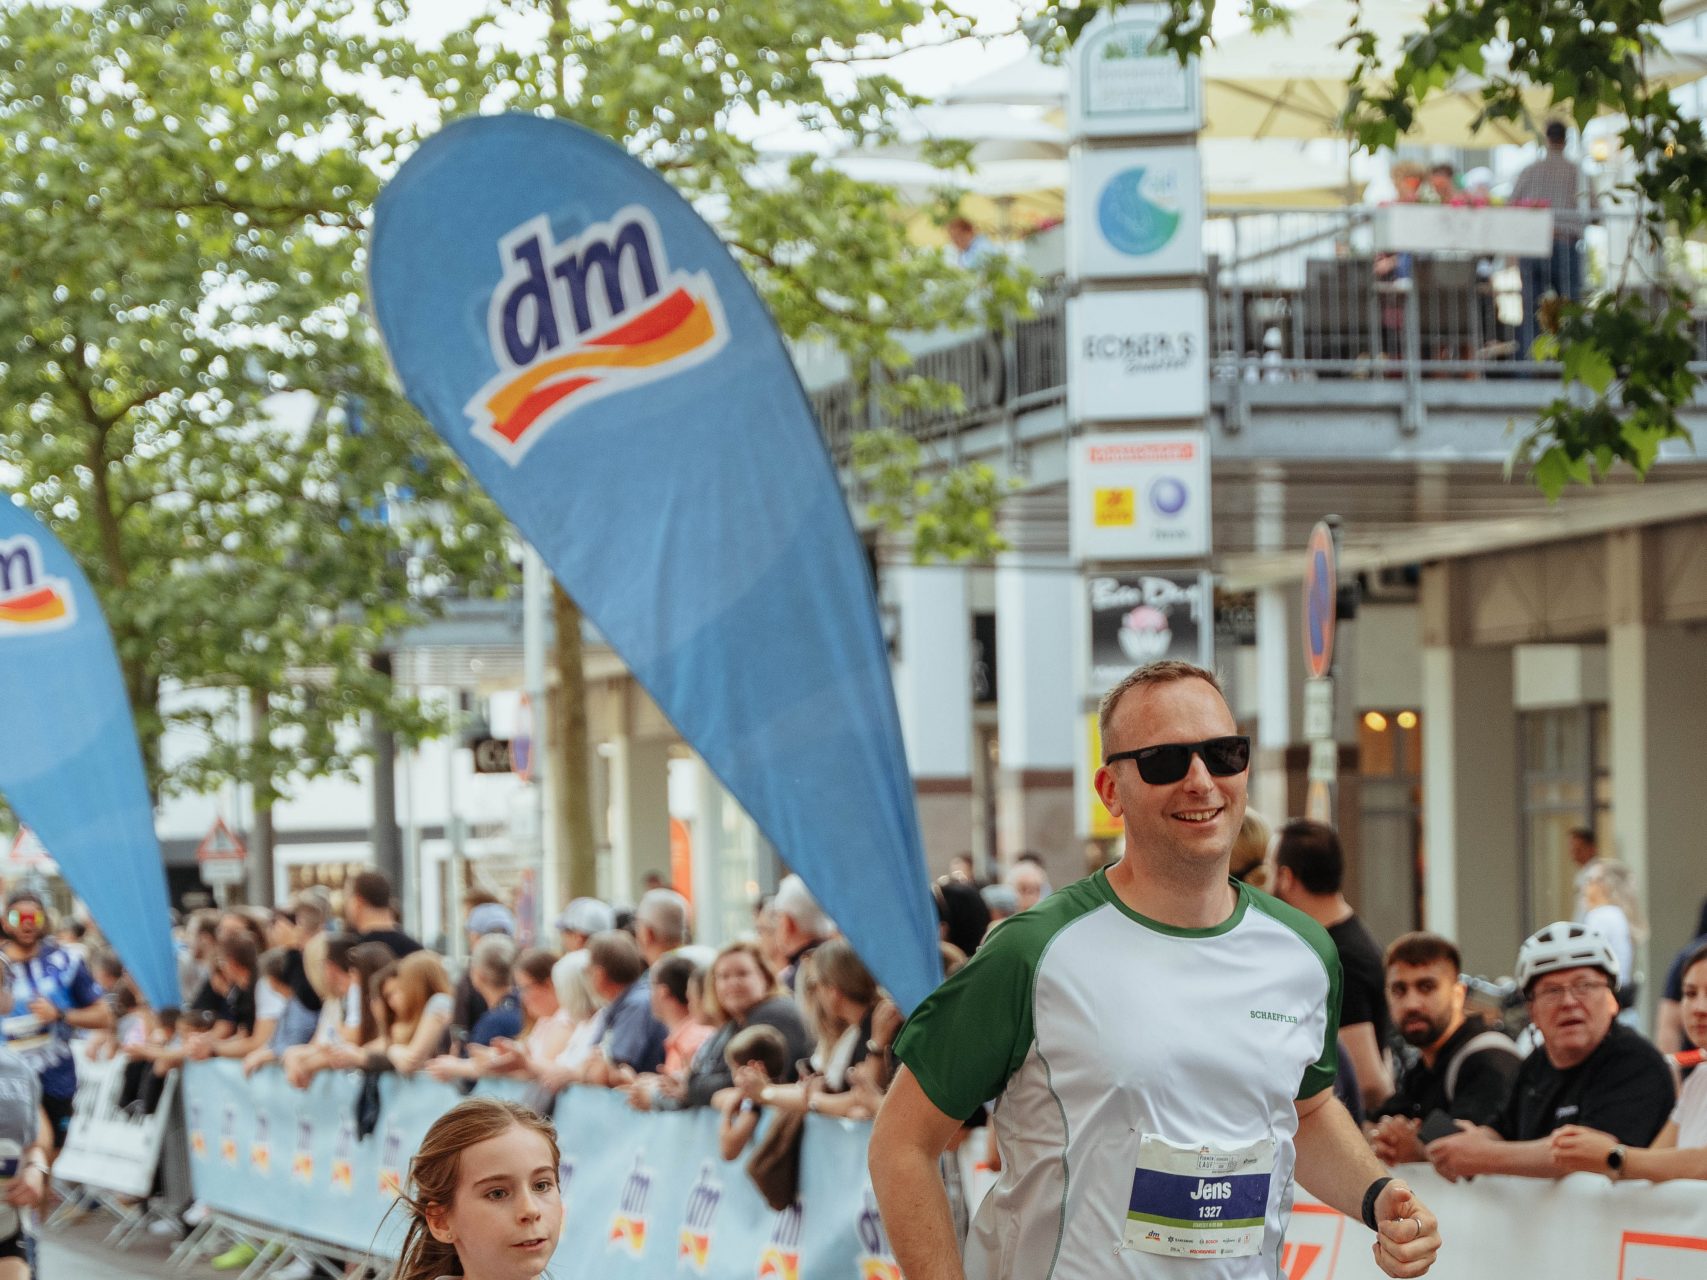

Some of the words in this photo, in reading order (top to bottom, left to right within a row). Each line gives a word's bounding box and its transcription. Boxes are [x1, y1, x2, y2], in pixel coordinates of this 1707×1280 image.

[501, 221, 660, 366] dm
[0, 546, 34, 592] m
[1190, 1178, 1232, 1201] Jens
[1198, 1205, 1223, 1219] 1327
